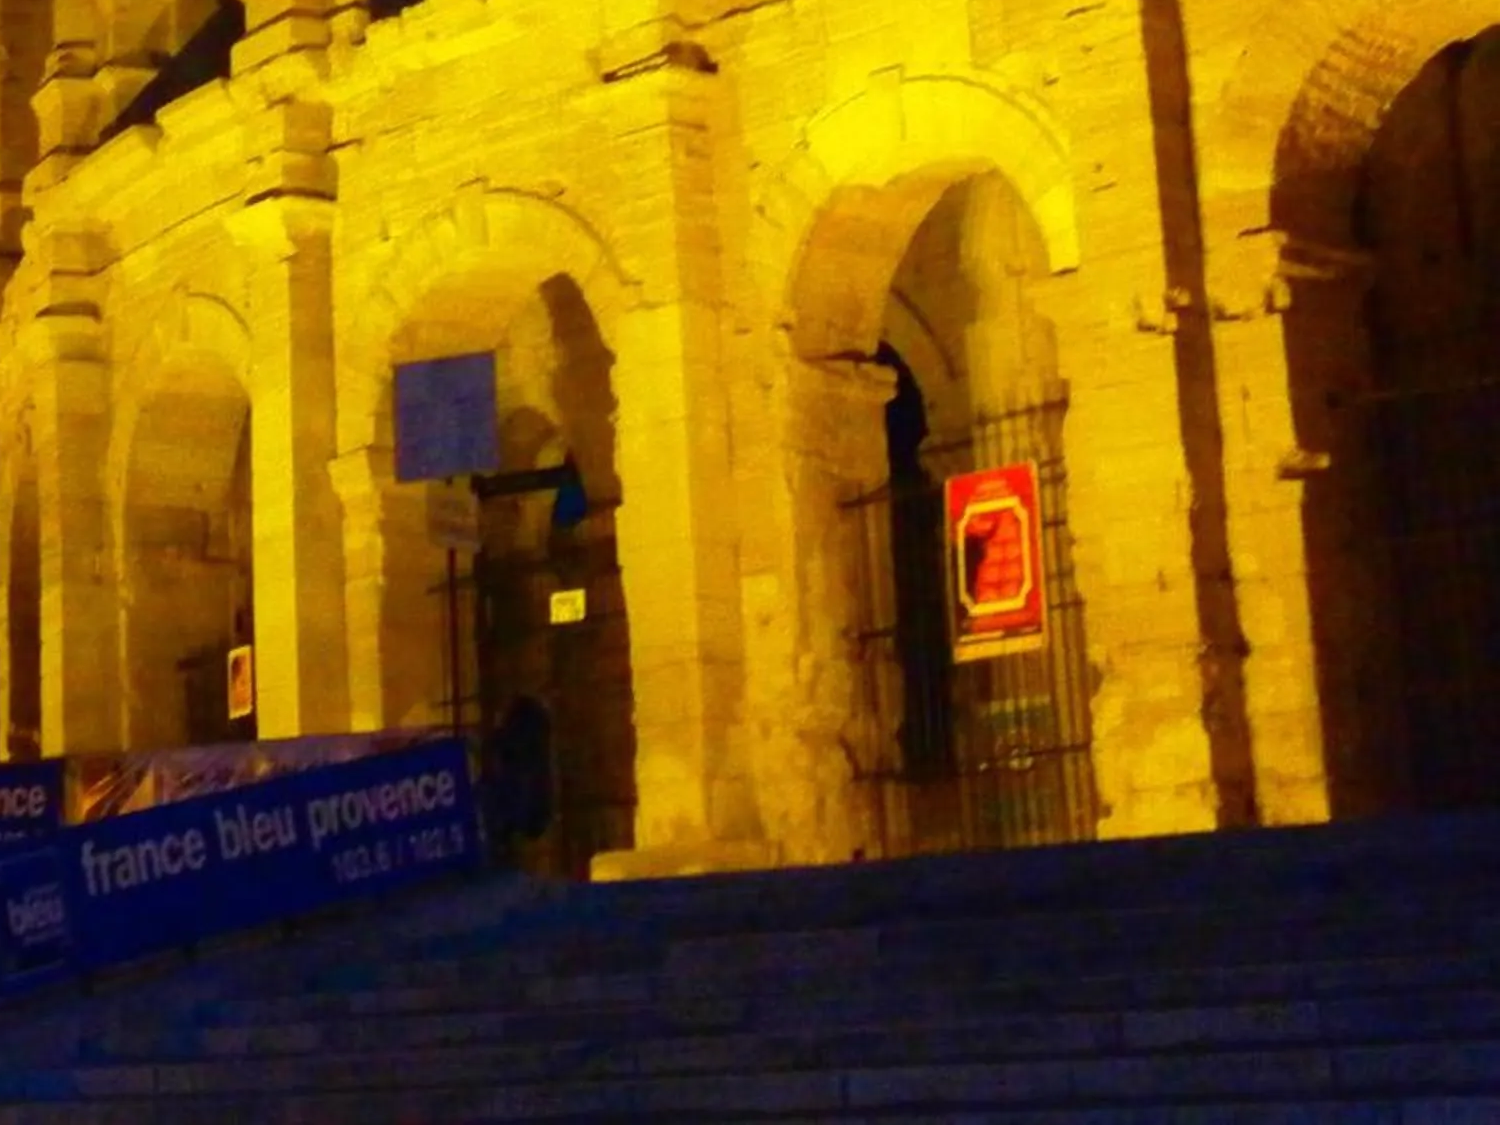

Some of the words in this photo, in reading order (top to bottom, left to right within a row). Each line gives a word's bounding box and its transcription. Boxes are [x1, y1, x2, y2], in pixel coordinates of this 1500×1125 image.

[79, 826, 208, 898] france
[214, 802, 298, 861] bleu
[306, 767, 456, 852] provence
[6, 895, 65, 937] bleu
